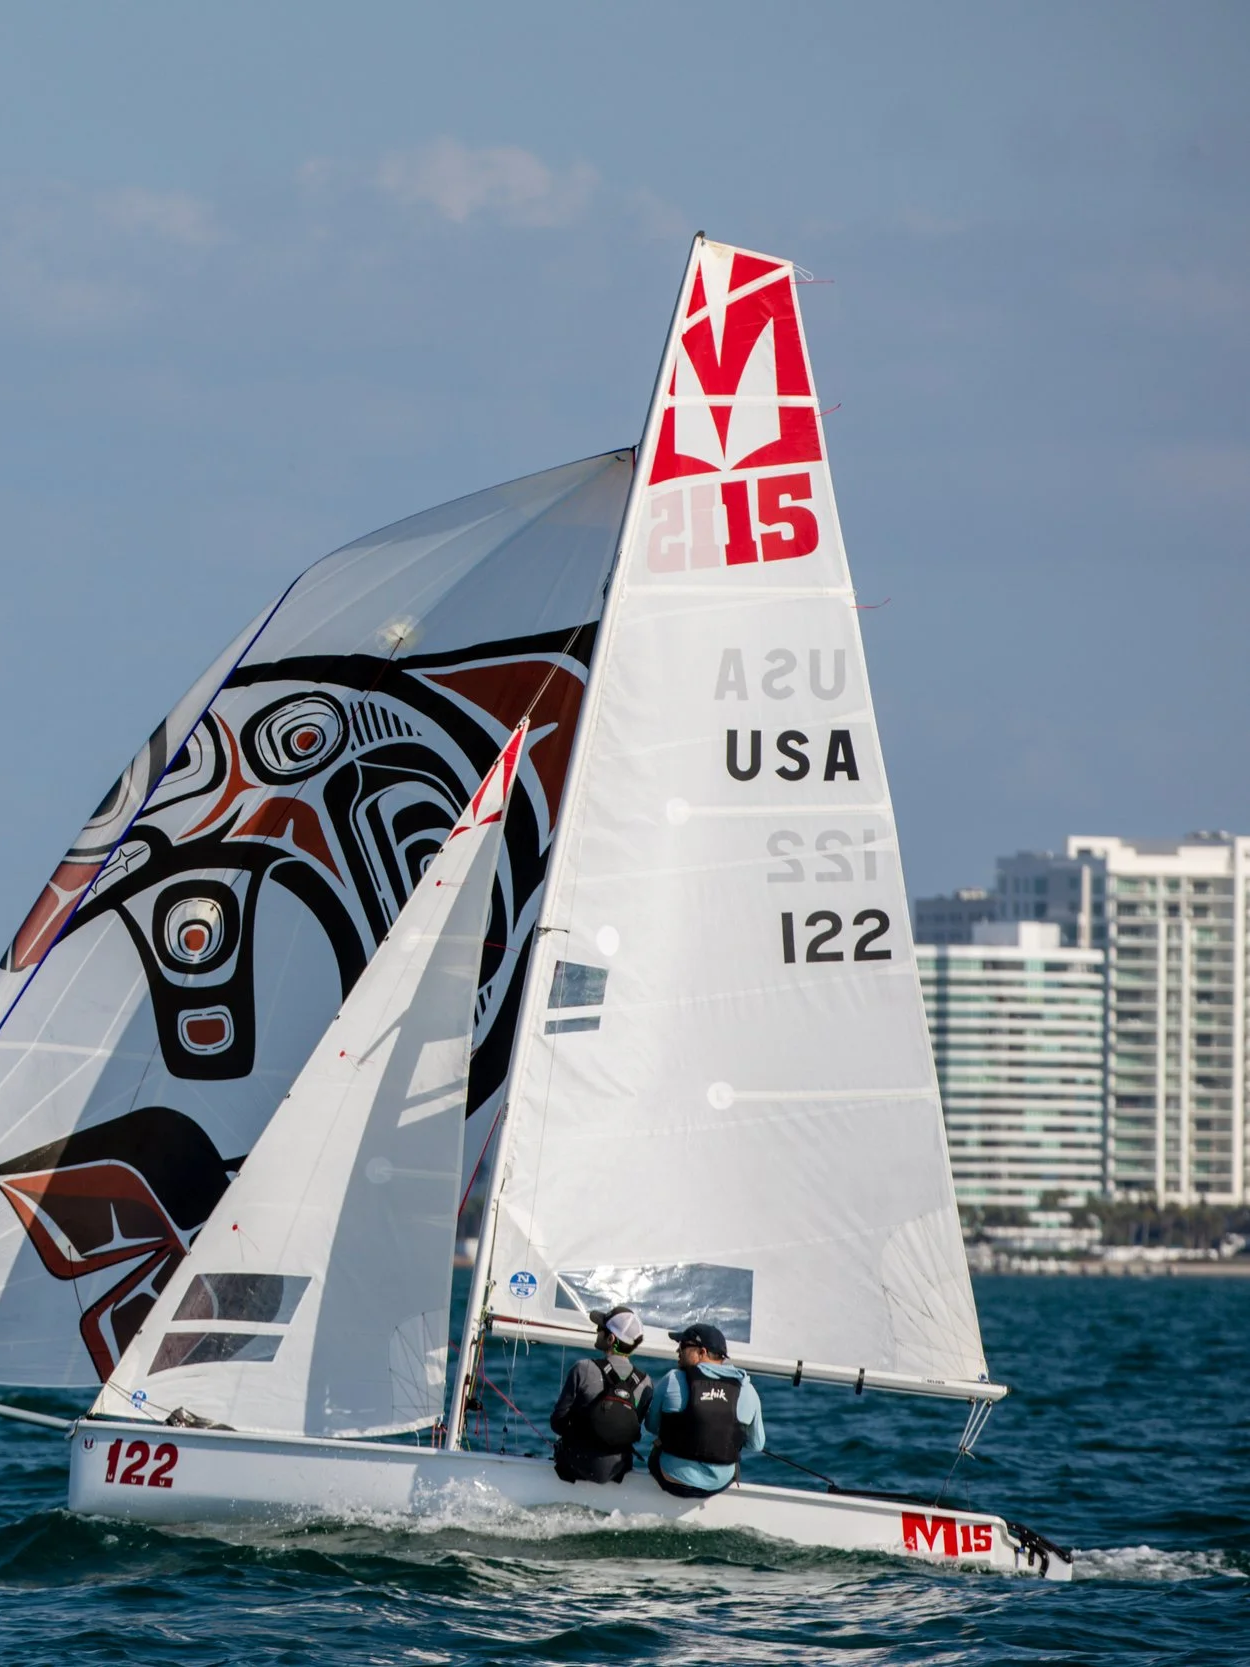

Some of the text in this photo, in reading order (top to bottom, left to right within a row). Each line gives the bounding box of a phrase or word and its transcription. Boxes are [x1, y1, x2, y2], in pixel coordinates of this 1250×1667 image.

[721, 472, 819, 566] 15
[726, 729, 860, 781] USA
[782, 909, 891, 963] 122
[700, 1387, 728, 1402] zhik
[105, 1438, 178, 1488] 122
